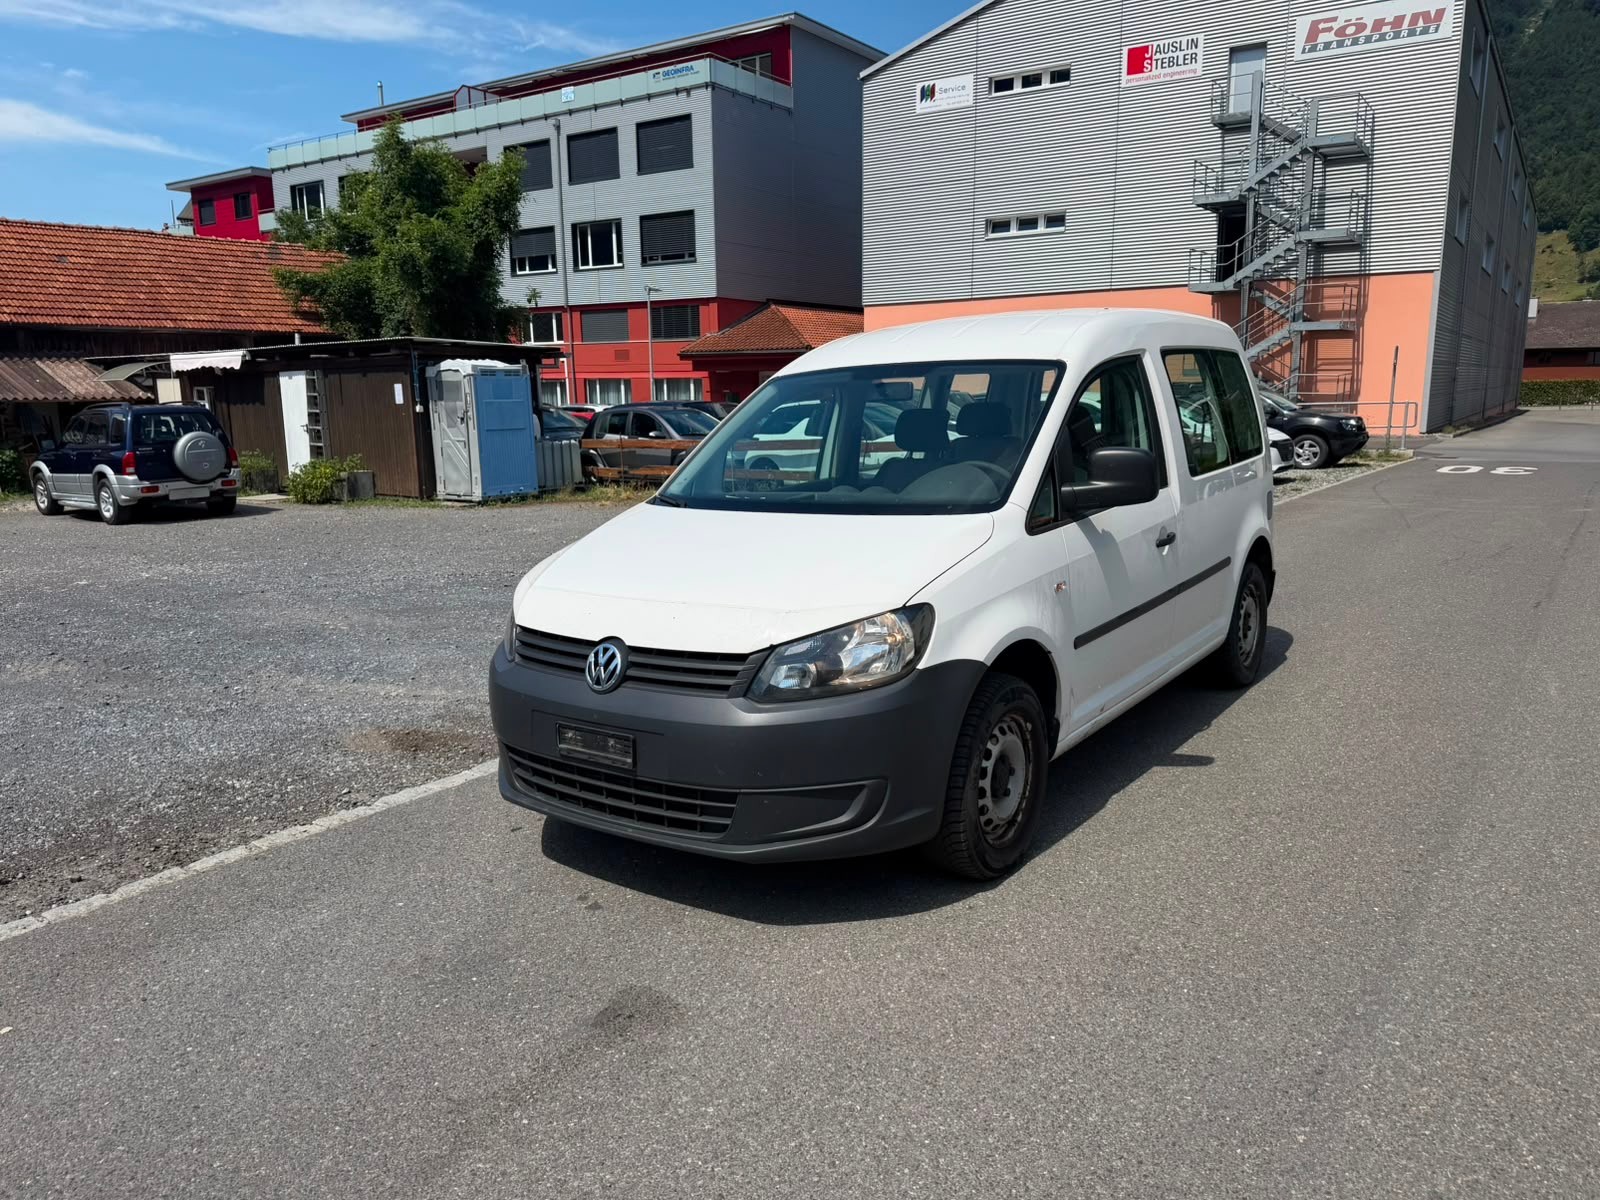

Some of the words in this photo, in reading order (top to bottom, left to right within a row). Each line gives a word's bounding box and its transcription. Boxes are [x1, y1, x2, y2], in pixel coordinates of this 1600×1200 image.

[1304, 7, 1446, 44] FÖHN
[1144, 37, 1199, 58] JAUSLIN
[1302, 25, 1440, 53] TRANSPORTE
[1143, 52, 1198, 73] STEBLER
[1162, 68, 1198, 79] engineering
